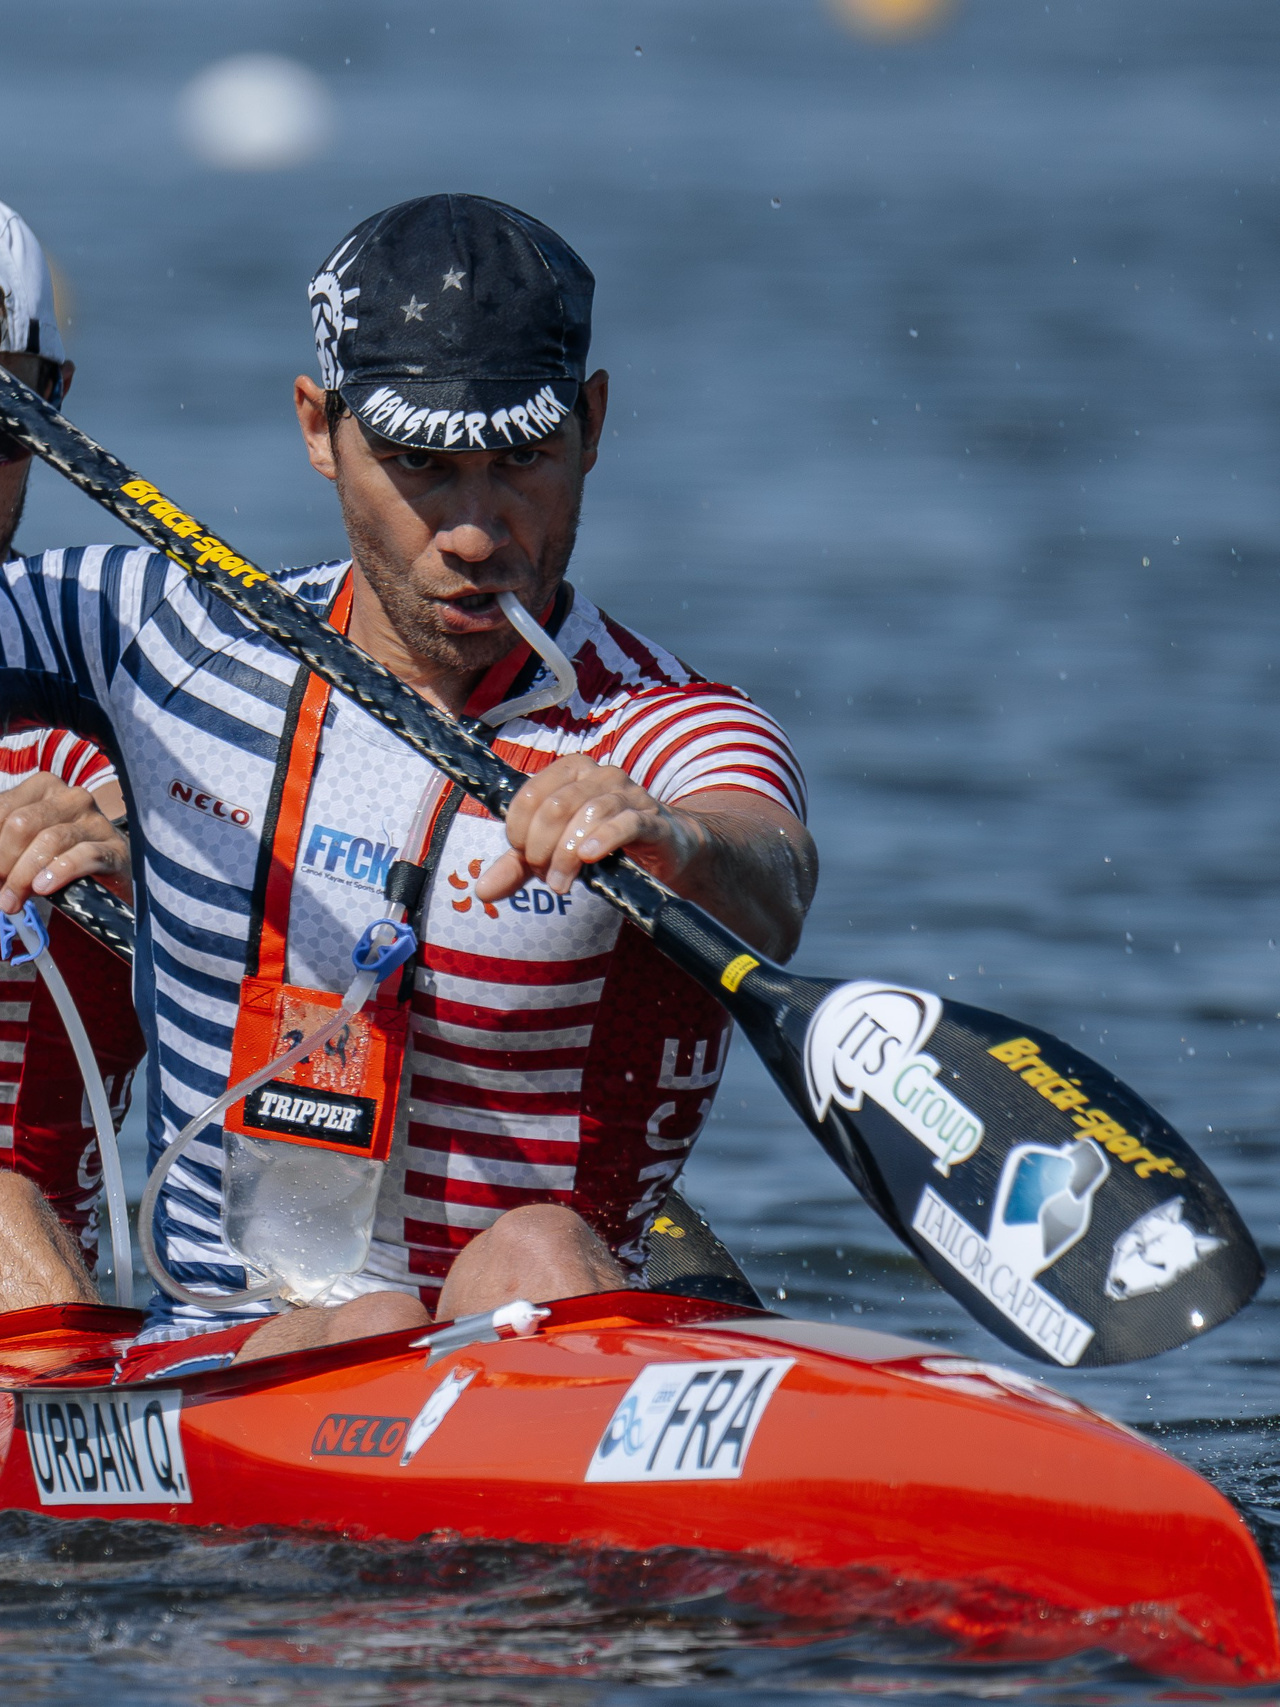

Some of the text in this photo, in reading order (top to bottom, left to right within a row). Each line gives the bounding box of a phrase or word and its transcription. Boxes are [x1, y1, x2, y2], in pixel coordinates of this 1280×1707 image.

[359, 385, 570, 449] MONSTER TRACK
[171, 780, 251, 826] NELO
[303, 824, 400, 887] FFCK
[837, 1012, 978, 1165] ITS Group
[922, 1193, 1083, 1358] TAILOR CAPITAL
[25, 1400, 186, 1499] URBAN Q.
[314, 1417, 407, 1454] NELO
[645, 1366, 774, 1471] FRA
